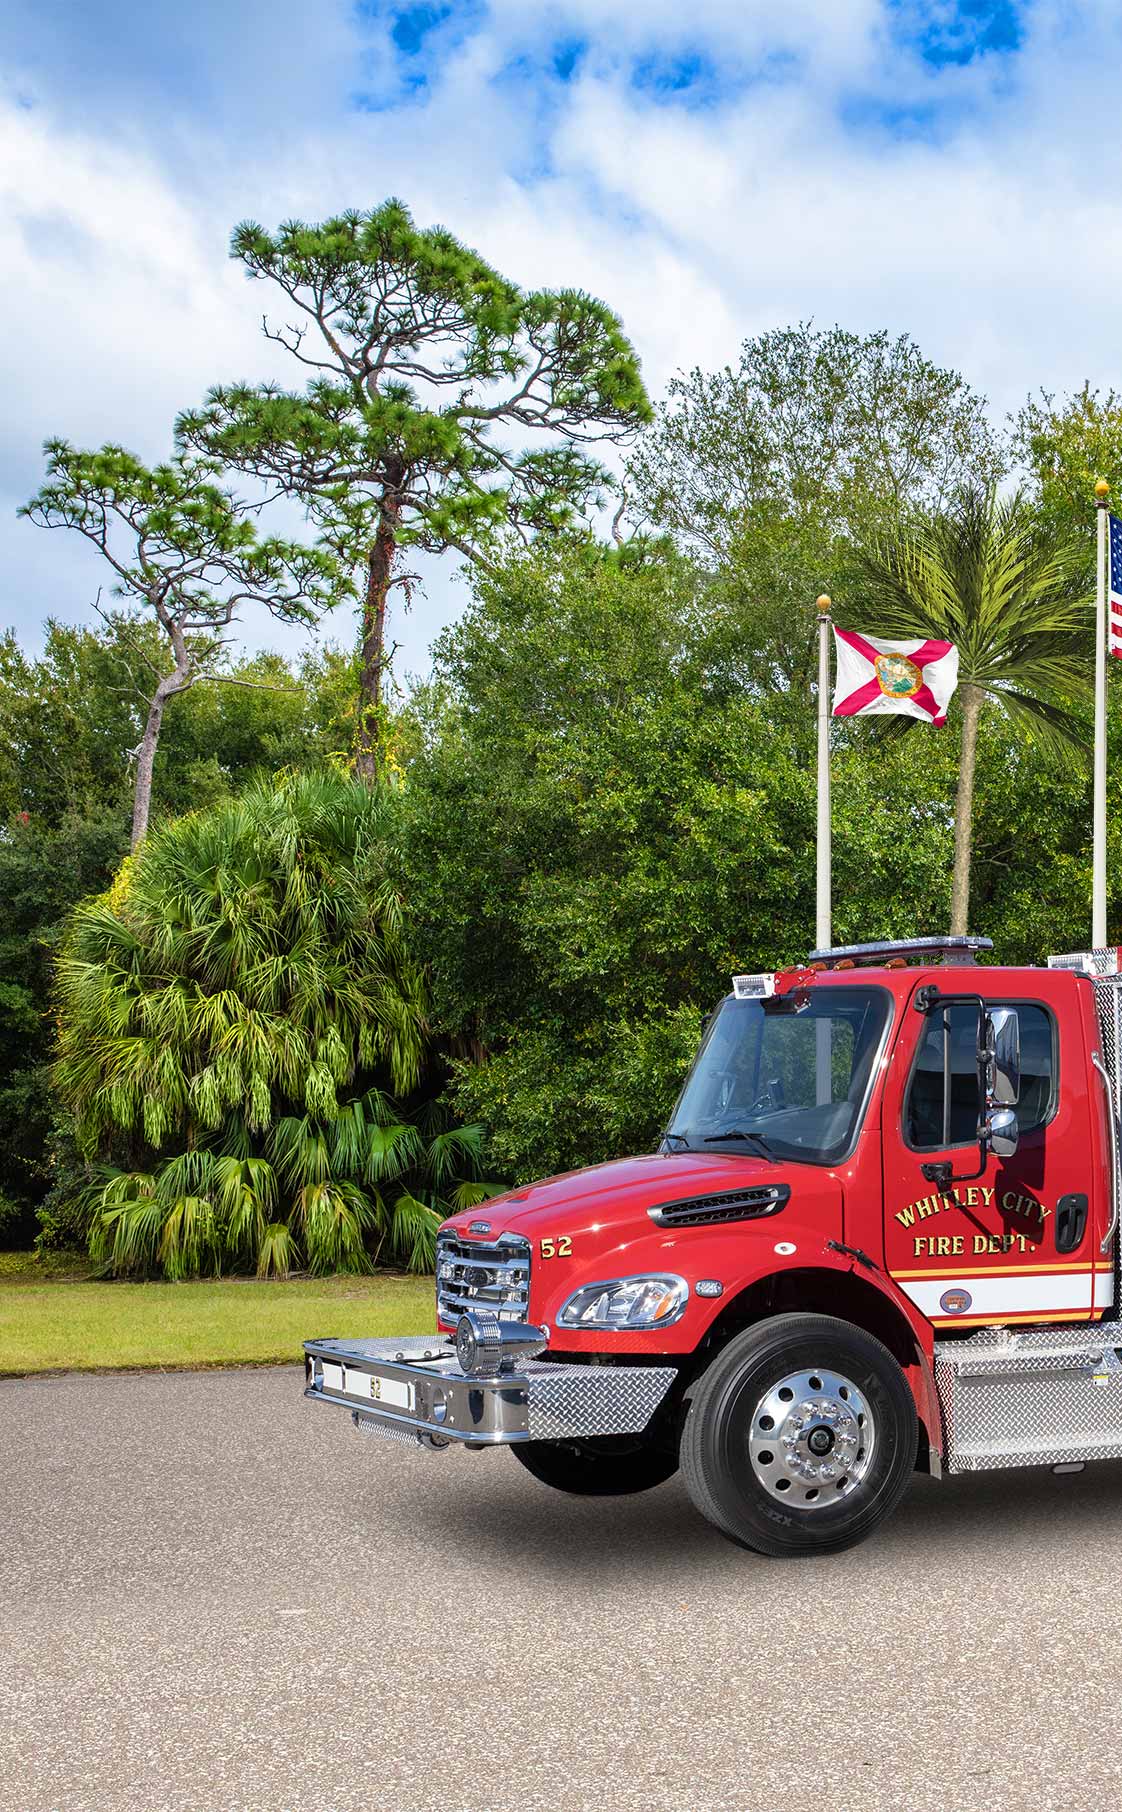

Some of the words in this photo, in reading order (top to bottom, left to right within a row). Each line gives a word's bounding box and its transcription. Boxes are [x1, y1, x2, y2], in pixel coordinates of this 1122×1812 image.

[894, 1187, 995, 1230] WHITLEY
[1001, 1191, 1053, 1224] CITY
[540, 1235, 573, 1260] 52
[913, 1236, 965, 1257] FIRE
[972, 1234, 1036, 1255] DEPT.
[370, 1376, 382, 1399] 52
